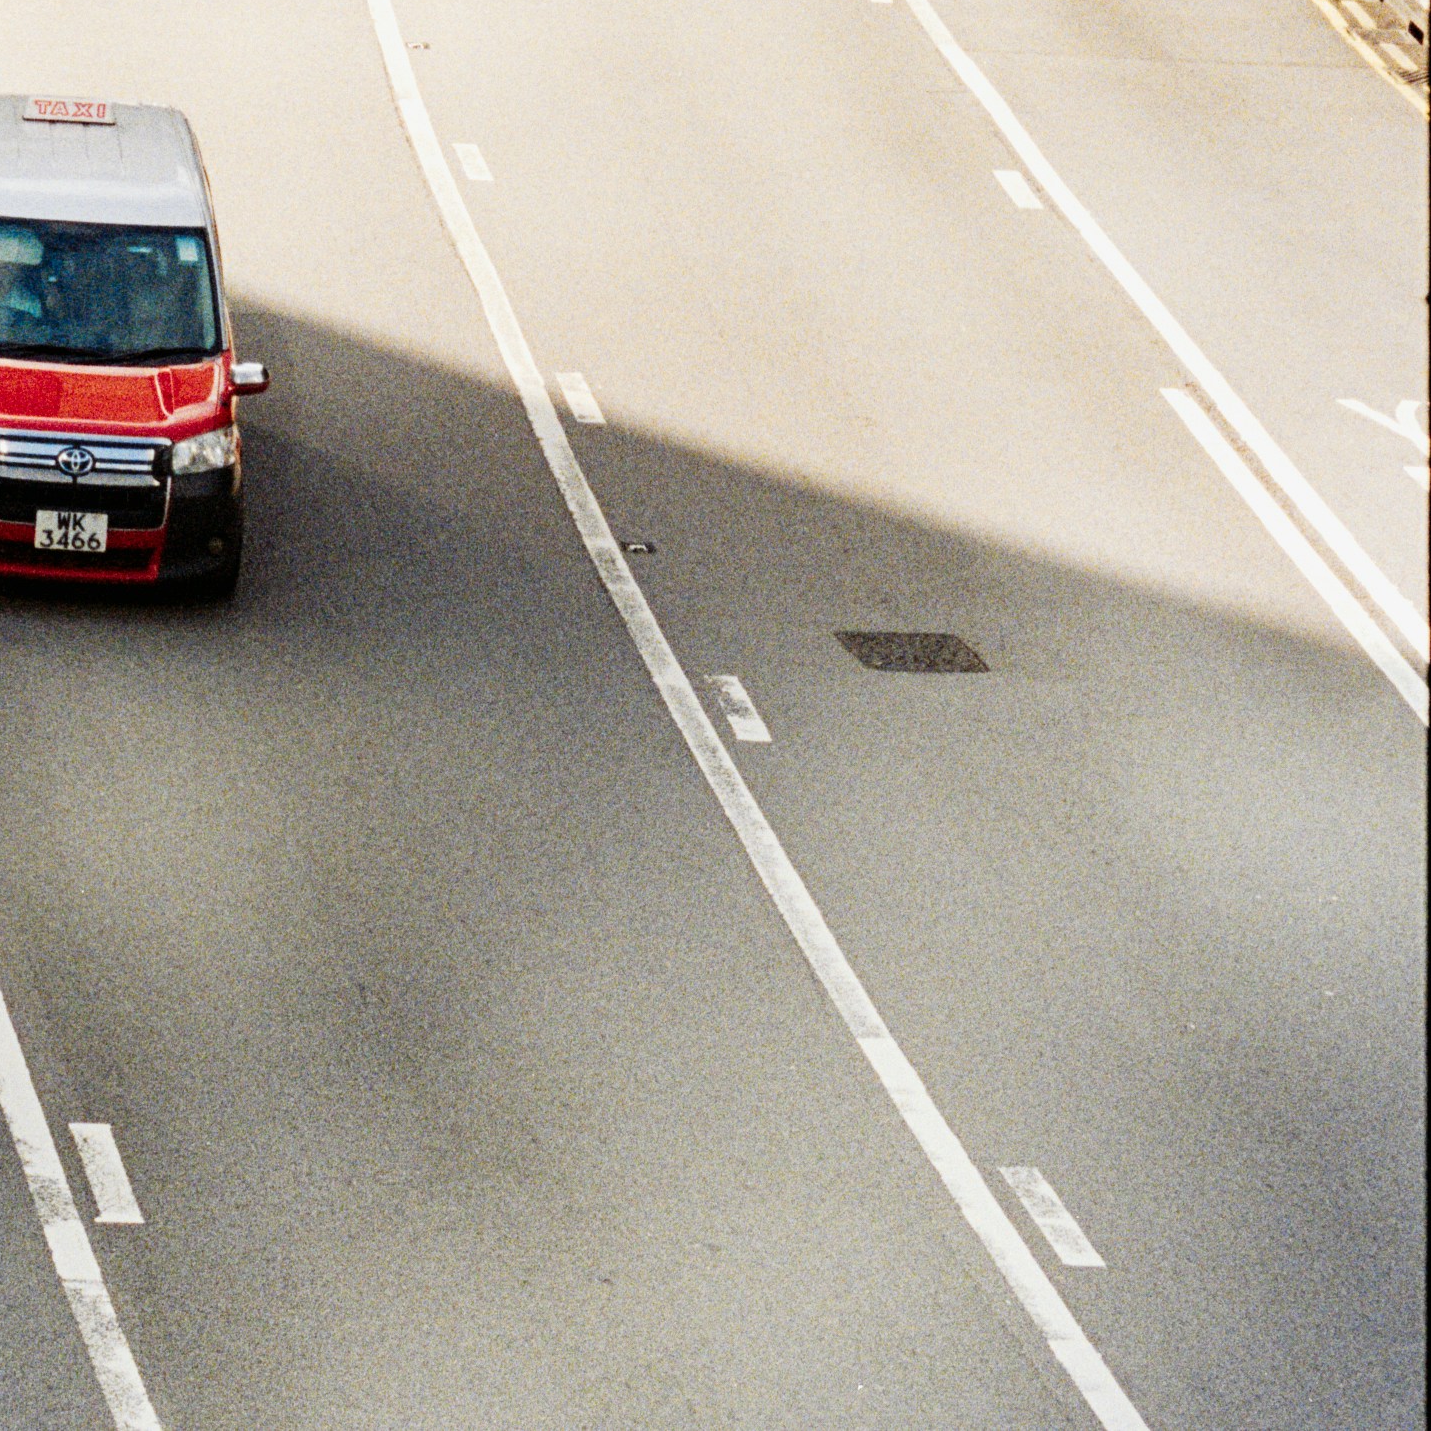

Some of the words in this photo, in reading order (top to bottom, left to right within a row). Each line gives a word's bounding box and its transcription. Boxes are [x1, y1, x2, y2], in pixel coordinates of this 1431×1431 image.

[35, 98, 107, 119] TAXI
[56, 512, 87, 532] WK
[40, 529, 102, 552] 3466
